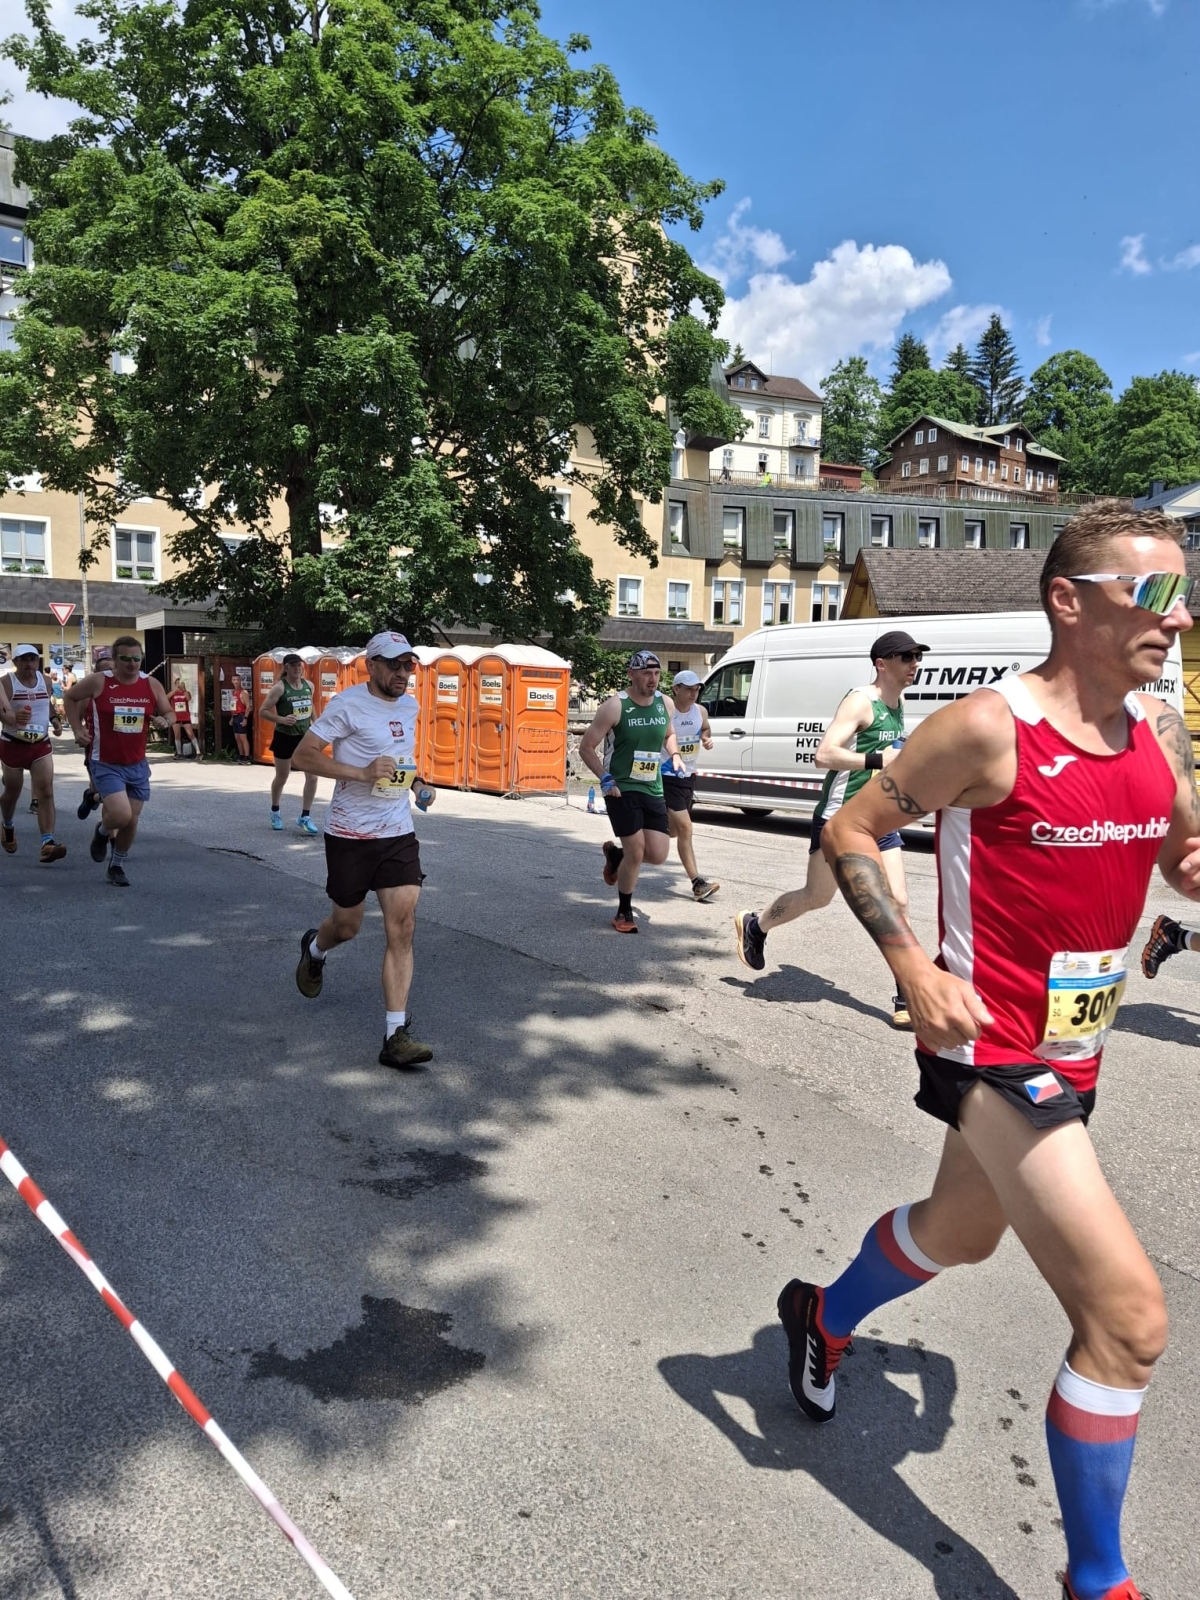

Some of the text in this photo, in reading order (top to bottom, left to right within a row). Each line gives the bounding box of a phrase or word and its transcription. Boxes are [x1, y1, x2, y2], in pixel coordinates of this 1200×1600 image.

[438, 681, 457, 690] Boels
[481, 679, 501, 687] Boels
[529, 691, 554, 701] Boels
[121, 716, 138, 724] 189
[628, 717, 667, 727] IRELAND
[797, 722, 825, 733] FUEL
[796, 737, 821, 748] HYD
[680, 744, 694, 753] 450
[795, 752, 816, 764] PER
[640, 762, 656, 771] 348
[1070, 986, 1117, 1026] 300
